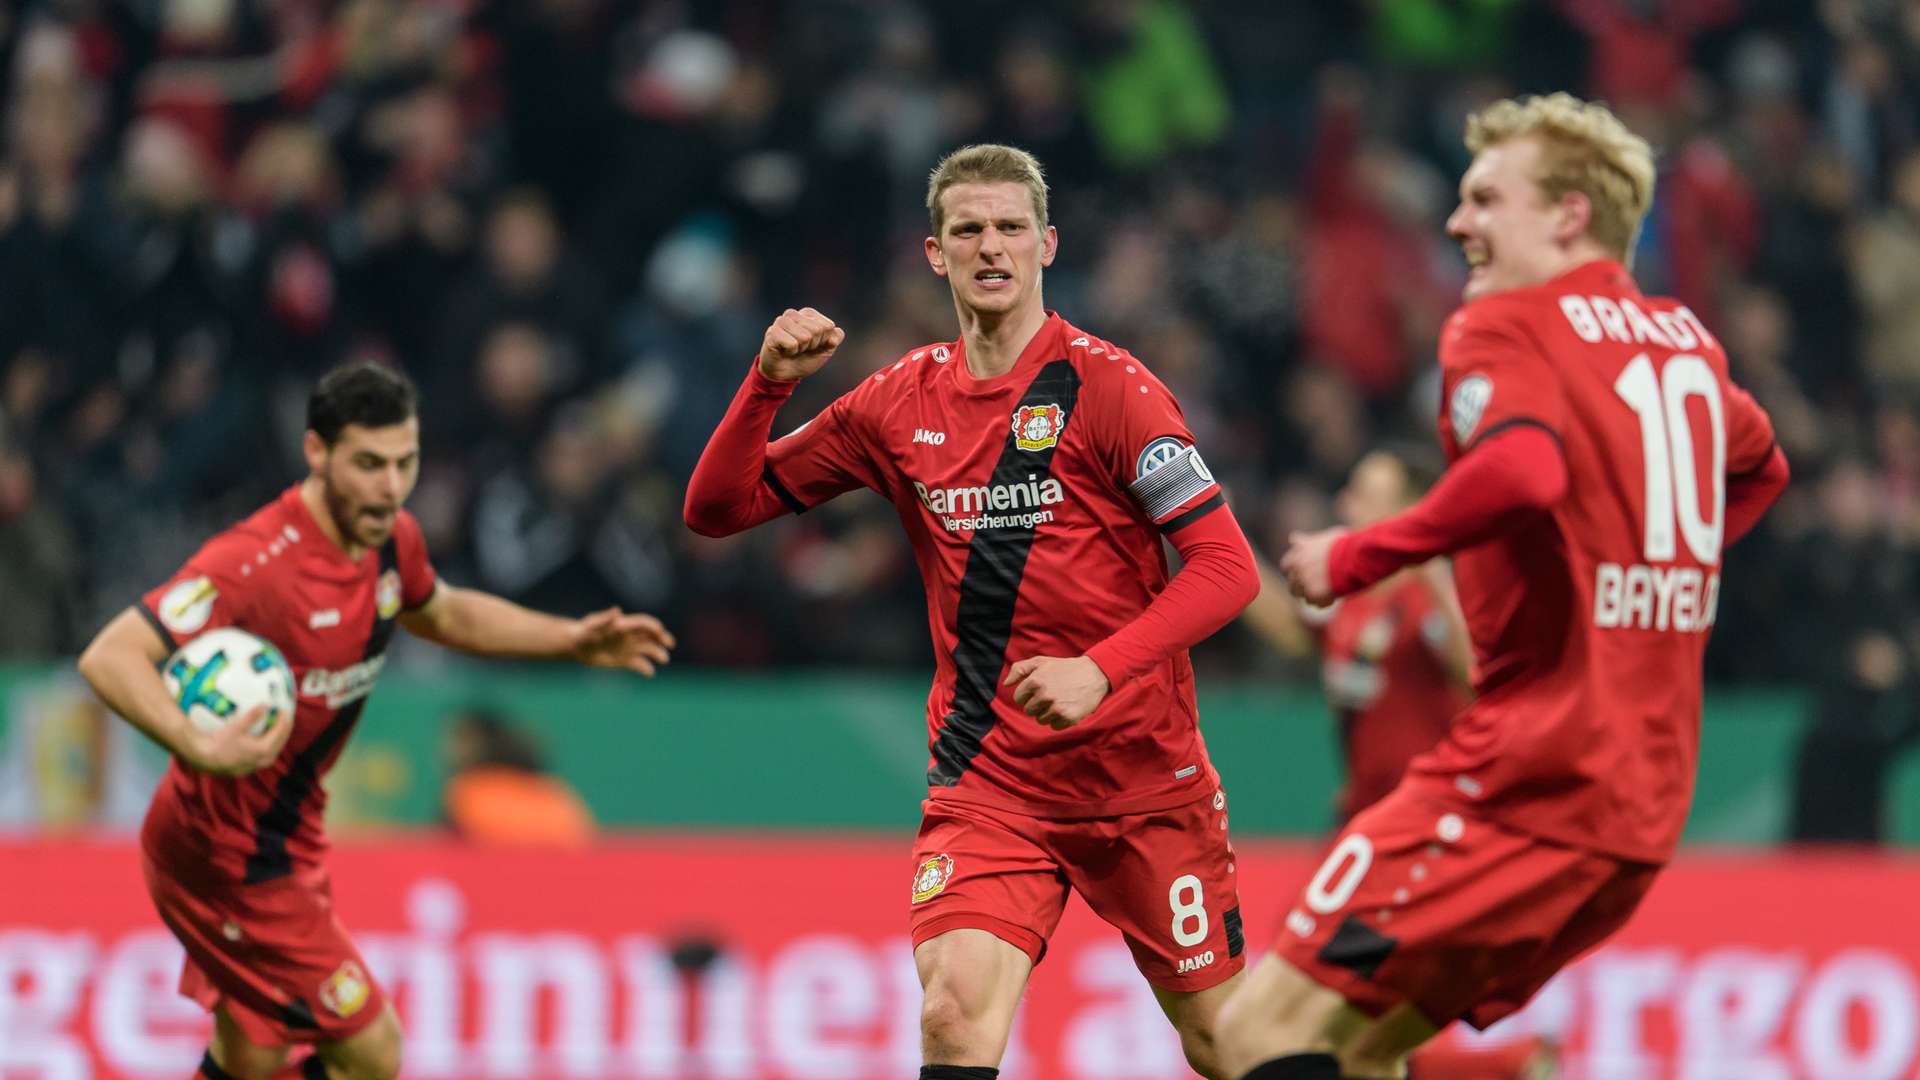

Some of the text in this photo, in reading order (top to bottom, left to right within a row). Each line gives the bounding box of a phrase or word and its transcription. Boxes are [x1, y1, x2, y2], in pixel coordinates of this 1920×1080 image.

[913, 428, 946, 446] JAKO
[1614, 352, 1725, 565] 10
[913, 473, 1065, 514] Barmenia
[942, 510, 1054, 531] Versicherungen
[1169, 874, 1208, 947] 8
[1177, 950, 1216, 974] JAKO
